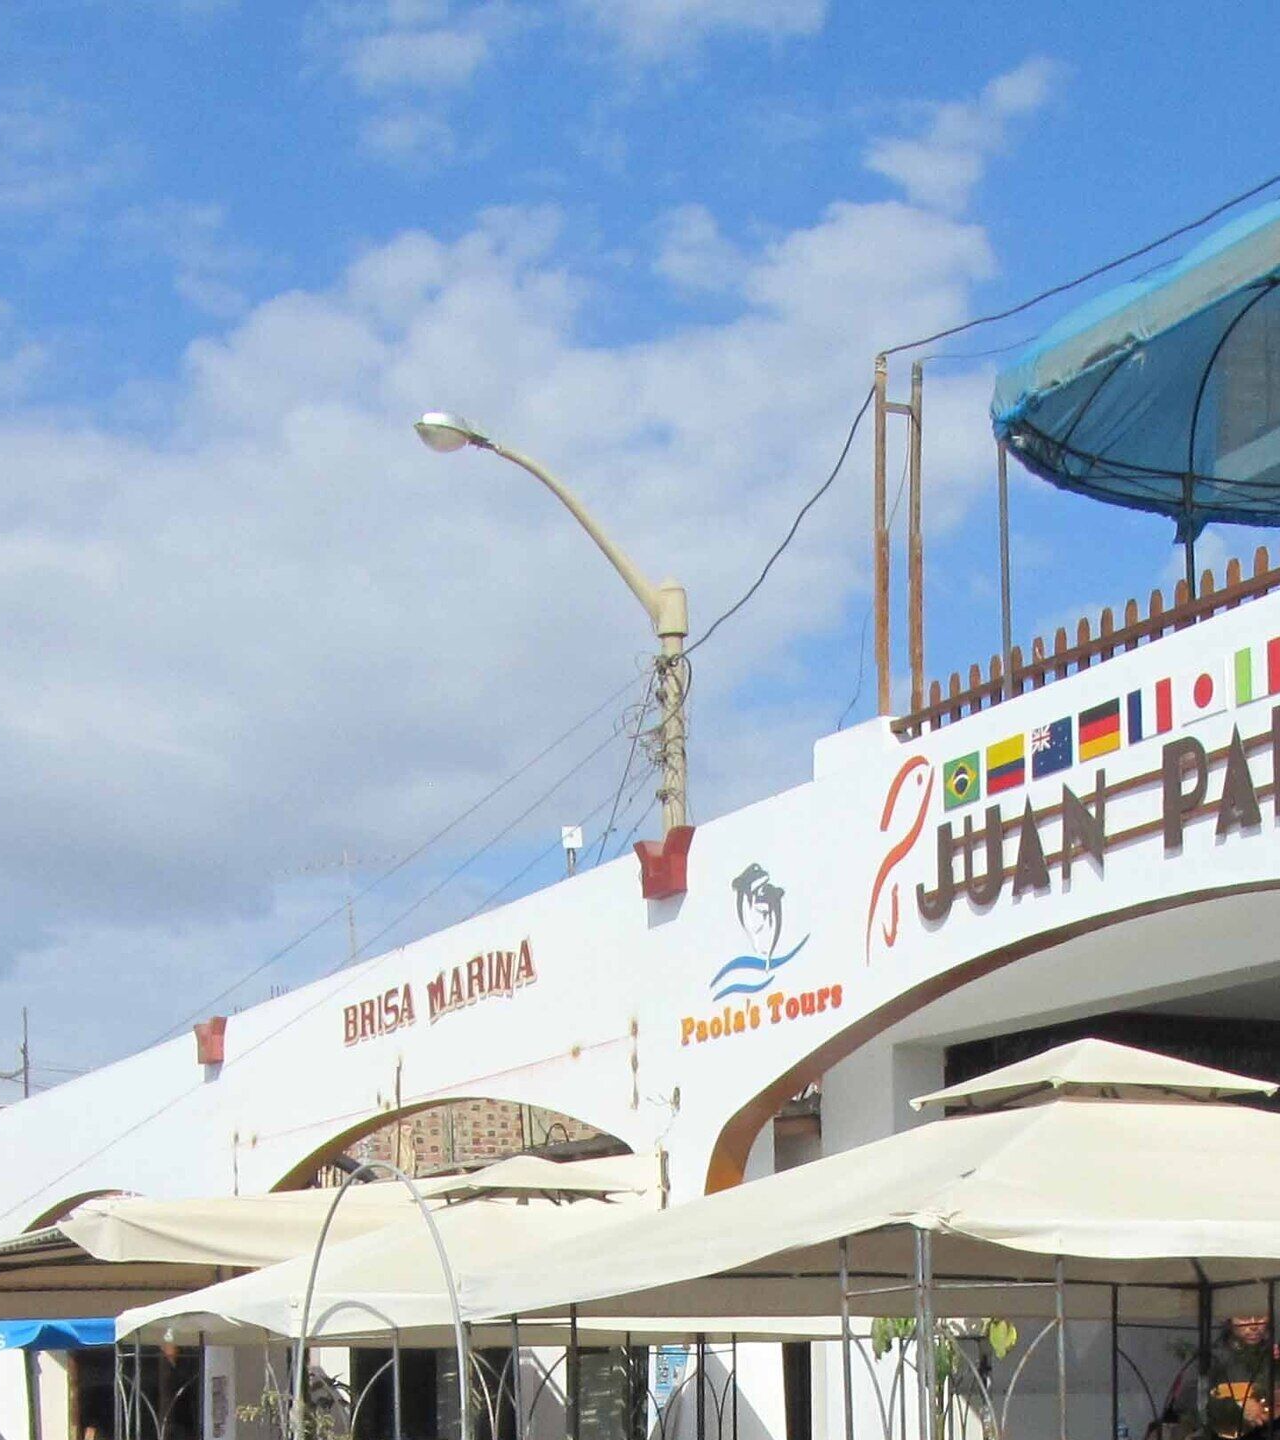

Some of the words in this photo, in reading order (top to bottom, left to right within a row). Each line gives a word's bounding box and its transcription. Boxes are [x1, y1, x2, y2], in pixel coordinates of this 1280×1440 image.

[915, 769, 1108, 920] JUAN
[342, 981, 417, 1048] BRISA
[426, 936, 538, 1026] MARINA
[680, 998, 761, 1047] Paola's
[766, 983, 843, 1025] Tours
